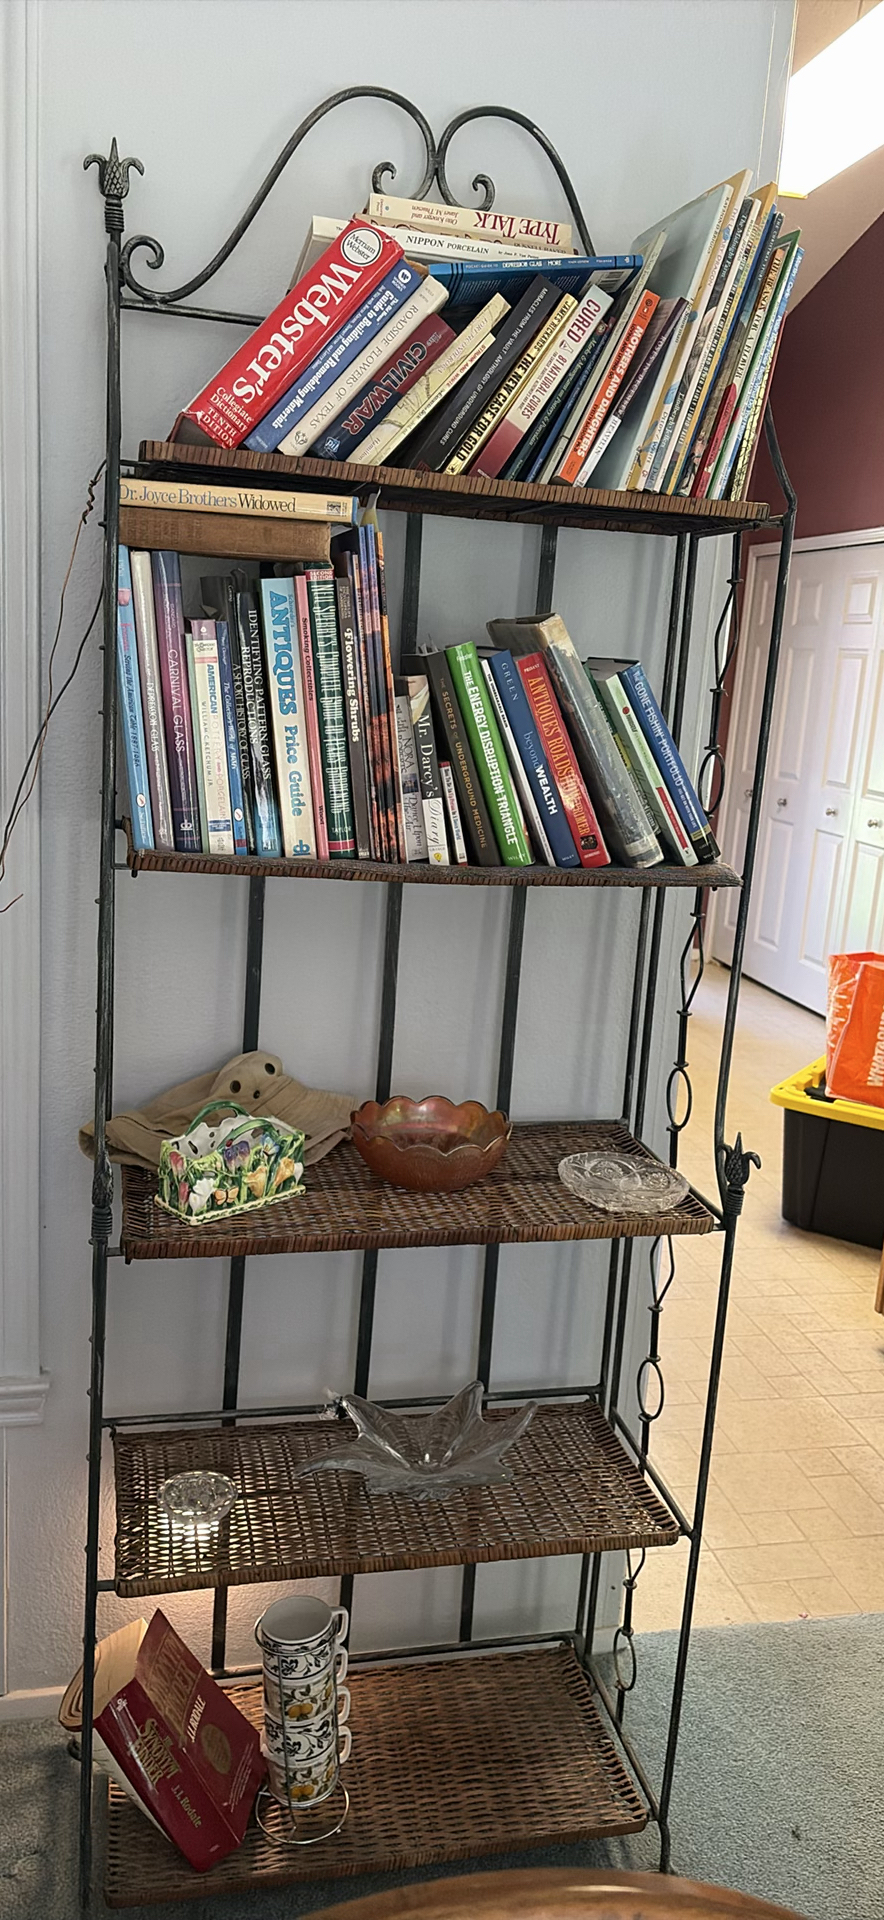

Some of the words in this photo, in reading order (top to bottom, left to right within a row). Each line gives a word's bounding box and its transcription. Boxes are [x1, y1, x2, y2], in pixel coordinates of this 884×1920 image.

[410, 212, 421, 220] and
[471, 209, 519, 238] TALK
[728, 207, 738, 223] THE
[737, 214, 748, 229] The
[774, 217, 782, 228] THE
[350, 233, 376, 255] Merriam
[405, 234, 444, 248] NIPPON
[446, 241, 489, 254] PORCELAIN
[516, 216, 563, 245] TYPE
[725, 228, 743, 260] Midnight
[346, 240, 370, 260] Webster
[763, 230, 777, 262] CHRISTMAS
[706, 254, 722, 287] DRAGON
[719, 260, 732, 280] Farm
[768, 257, 782, 276] THE
[788, 255, 803, 277] Martin
[371, 289, 394, 314] Guide
[527, 287, 548, 313] MIRACLES
[755, 277, 777, 312] REASON
[782, 281, 794, 300] Carle
[365, 309, 377, 321] to
[552, 300, 572, 323] JAMES
[721, 295, 733, 316] STINKY
[233, 262, 362, 403] Webster's
[340, 315, 372, 349] Building
[379, 304, 419, 347] ROADSIDE
[510, 327, 521, 339] THE
[517, 312, 531, 328] FROM
[566, 298, 601, 344] CURED
[623, 322, 636, 342] LOVING
[673, 311, 690, 344] Snowman
[750, 313, 762, 331] FOR
[532, 321, 558, 352] RICKARDS
[582, 338, 597, 356] Marks
[613, 325, 646, 375] MOTHERS
[618, 341, 627, 353] AND
[648, 335, 666, 361] ROSES
[708, 338, 717, 352] MAN
[331, 343, 348, 361] and
[382, 341, 427, 391] CIVIL
[467, 344, 487, 364] STRUNK
[516, 352, 536, 374] THE
[555, 354, 567, 367] 81
[610, 353, 622, 372] LETTING
[704, 352, 713, 366] AND
[734, 343, 751, 379] FLOWER
[296, 355, 337, 400] Remodeling
[343, 345, 382, 388] FLOWERS
[445, 372, 460, 388] WHITE
[458, 361, 470, 374] AND
[478, 353, 504, 385] ANTHOLOGY
[532, 363, 563, 397] NATURAL
[559, 359, 584, 390] Monograms
[641, 361, 652, 373] IN
[698, 366, 710, 385] OTHER
[332, 385, 347, 401] OF
[474, 383, 483, 392] OF
[500, 370, 523, 395] NEW
[602, 373, 622, 400] AND
[209, 394, 248, 433] Dictionary
[216, 386, 252, 423] Collegiate
[270, 394, 304, 430] Materials
[307, 399, 335, 429] TEXAS
[342, 380, 392, 436] WAR
[449, 390, 479, 429] UNDERGROUND
[484, 391, 508, 418] CASE
[518, 393, 542, 420] CURES
[544, 395, 562, 416] Pottery
[587, 403, 598, 421] EVELYN
[666, 391, 686, 427] Lindbergh
[207, 406, 238, 438] TENTH
[438, 427, 454, 445] CURES
[471, 415, 491, 437] FOR
[526, 420, 546, 446] Porcelain
[573, 396, 611, 458] DAUGHTERS
[655, 411, 669, 433] DEEDY
[677, 427, 688, 444] TALES
[356, 436, 381, 463] Hamilton
[454, 434, 478, 462] GOLD
[594, 418, 619, 456] HEAVILIN
[644, 440, 659, 464] WHITE
[120, 484, 138, 500] Dr.
[139, 486, 176, 504] Joyce
[178, 488, 238, 508] Brothers
[237, 493, 296, 512] Widowed
[309, 568, 332, 576] SECOND
[310, 573, 333, 581] EDITION
[313, 583, 335, 602] NEIL
[287, 594, 296, 628] Schroeder's
[298, 616, 311, 654] Smoking
[315, 605, 338, 647] SPERRY'S
[247, 609, 264, 685] IDENTIFYING
[270, 590, 297, 716] ANTIQUES
[122, 654, 133, 676] Serving
[318, 650, 341, 693] COMPLETE
[341, 627, 358, 697] Flowering
[165, 648, 183, 712] CARNIVAL
[206, 663, 217, 714] AMERICAN
[232, 672, 244, 703] SHORT
[302, 655, 317, 702] Collectibles
[462, 669, 474, 686] THE
[498, 661, 521, 701] GREEN
[126, 688, 135, 714] American
[146, 681, 157, 727] DEPRESSION
[240, 646, 259, 744] REPRODUCTIONS
[321, 695, 343, 721] GUIDE
[466, 685, 489, 731] ENERGY
[129, 715, 137, 730] Table
[234, 703, 247, 738] HISTORY
[254, 688, 269, 741] PATTERN
[349, 698, 361, 742] Shrubs
[417, 714, 431, 738] Mr.
[149, 729, 159, 752] GLASS
[171, 713, 186, 752] GLASS
[210, 715, 221, 761] POTTERY
[325, 723, 343, 735] TO
[633, 681, 652, 708] GONE
[643, 706, 664, 739] FISHIN'
[657, 738, 684, 787] PORTFOLIO
[238, 741, 247, 752] OF
[285, 724, 298, 764] Price
[325, 737, 347, 763] TEXAS
[405, 737, 415, 769] NORA
[524, 674, 562, 738] ANTIQUES
[569, 799, 594, 836] PRIMER
[239, 753, 250, 780] GLASS
[259, 744, 272, 780] GLASS
[417, 743, 438, 798] Darcy's
[441, 691, 457, 730] SECRETS
[454, 741, 478, 807] UNDERGROUND
[472, 809, 488, 849] MEDICINE
[478, 729, 507, 795] DISRUPTION
[215, 774, 226, 819] PORCELAIN
[290, 770, 306, 817] Guide
[326, 766, 350, 814] GARDENING
[532, 764, 560, 815] WEALTH
[316, 805, 325, 826] Wood
[408, 796, 419, 822] Dance
[426, 799, 444, 844] Diary
[494, 794, 519, 845] TRIANGLE
[413, 824, 422, 847] Upon
[188, 1696, 206, 1734] RODALE
[134, 1738, 164, 1785] FINDER
[138, 1718, 180, 1779] SYNONYM
[180, 1796, 202, 1828] Rodale
